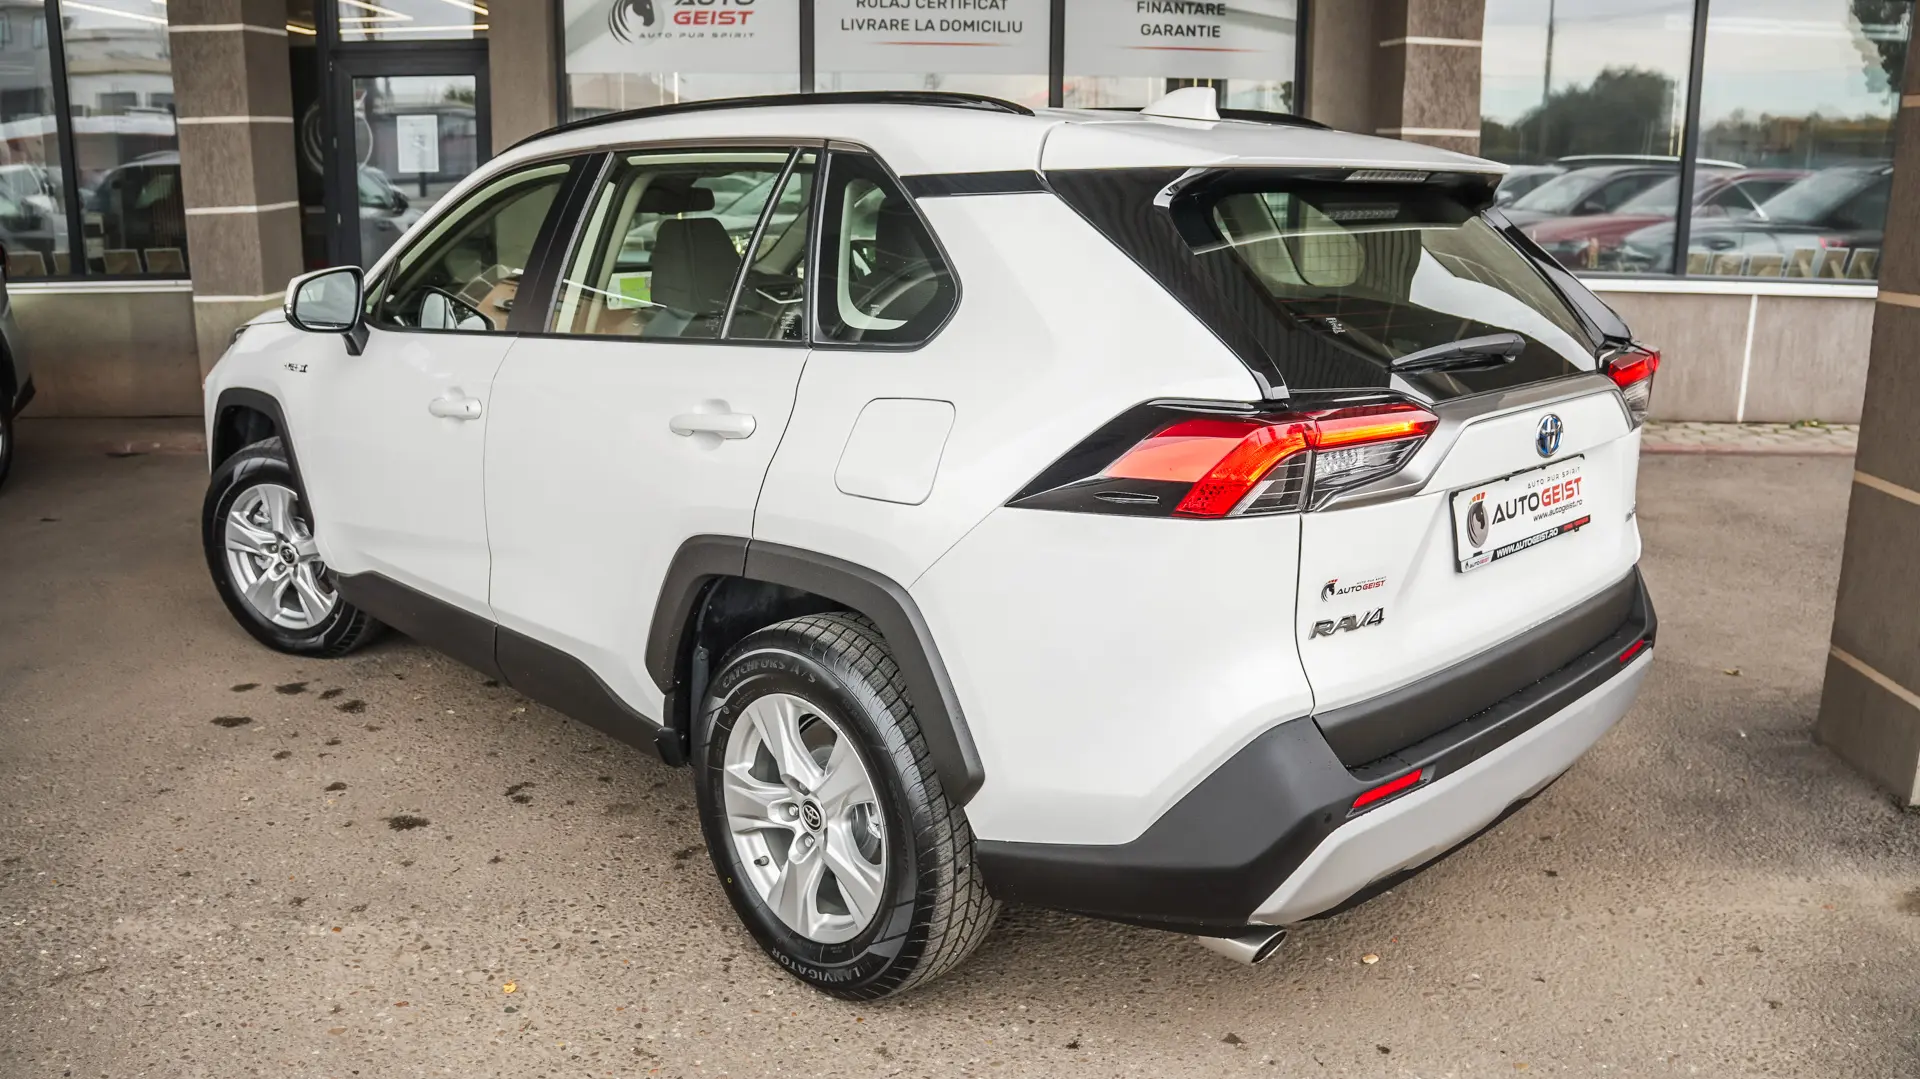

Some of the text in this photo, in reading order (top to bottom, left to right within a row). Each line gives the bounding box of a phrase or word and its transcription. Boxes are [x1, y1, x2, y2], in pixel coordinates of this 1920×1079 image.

[915, 0, 1008, 10] CERTIFICAT
[1137, 1, 1226, 16] FINANTARE
[673, 10, 755, 25] GEIST
[840, 18, 1023, 33] LIVRARE LA DOMICILIU
[1140, 23, 1221, 38] GARANTIE
[1527, 466, 1581, 489] AUTO PUR SPIRIT
[1492, 476, 1582, 525] AUTOGEIST
[1533, 499, 1583, 522] www.autogeist.ro
[1496, 527, 1559, 559] WWW.AUTOGEIST.RO
[1336, 579, 1386, 596] AUTOGEIST
[1308, 606, 1385, 640] RAV4
